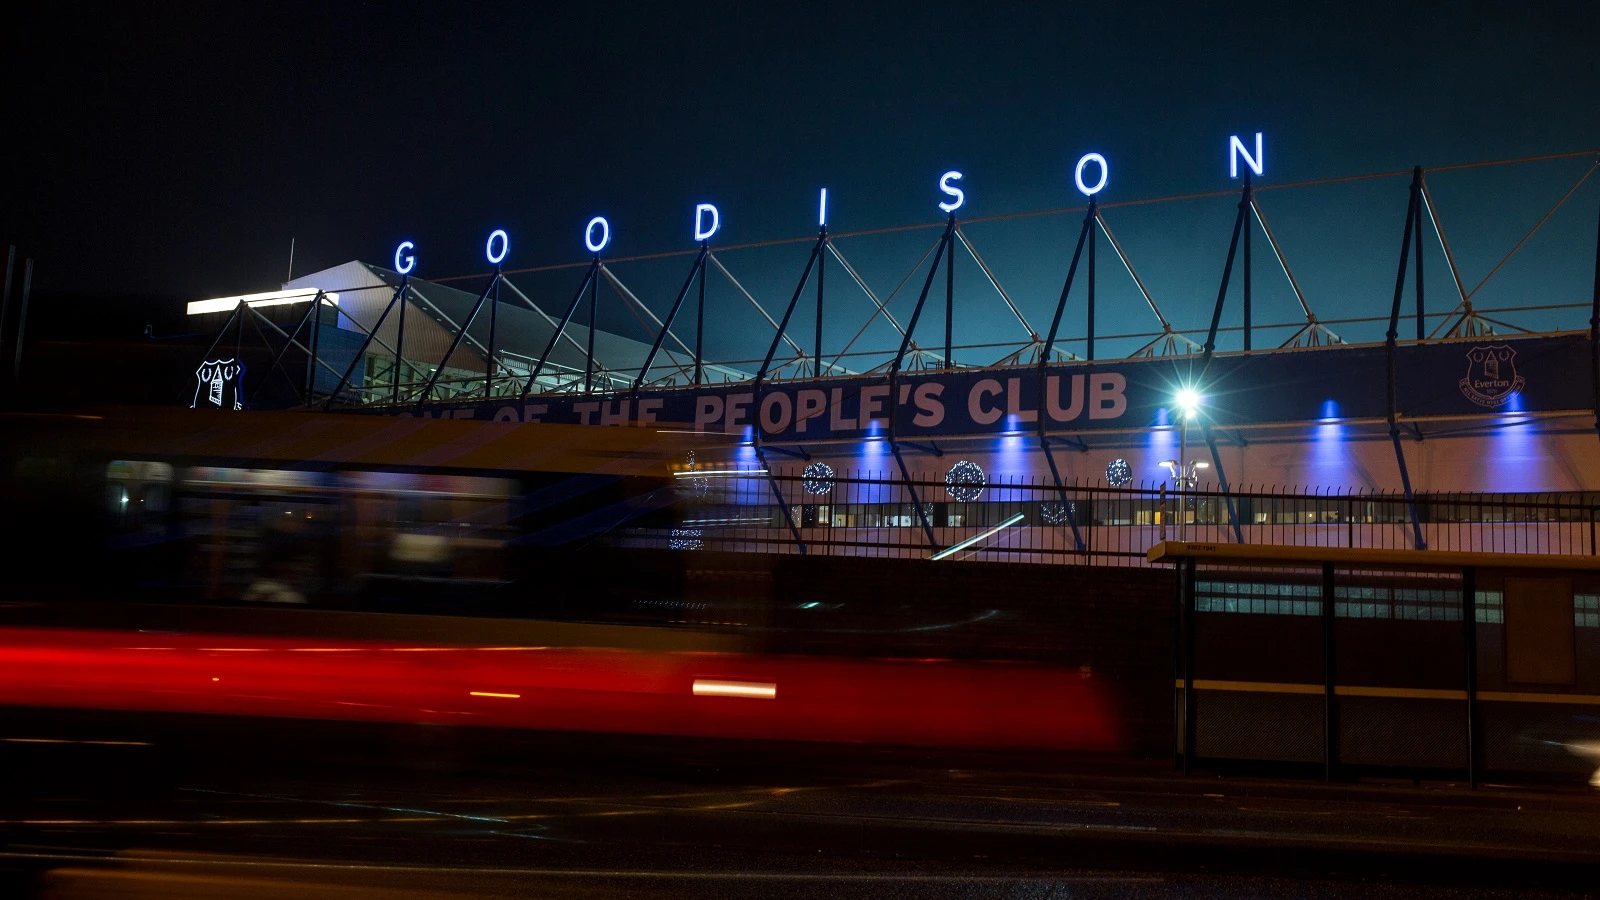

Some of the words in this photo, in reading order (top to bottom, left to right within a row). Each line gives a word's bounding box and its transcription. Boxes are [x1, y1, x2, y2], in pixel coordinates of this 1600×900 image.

[394, 131, 1264, 276] GOODISON
[573, 398, 664, 427] THE
[695, 382, 945, 437] PEOPLE'S
[968, 371, 1128, 425] CLUB
[1474, 380, 1509, 388] Everton
